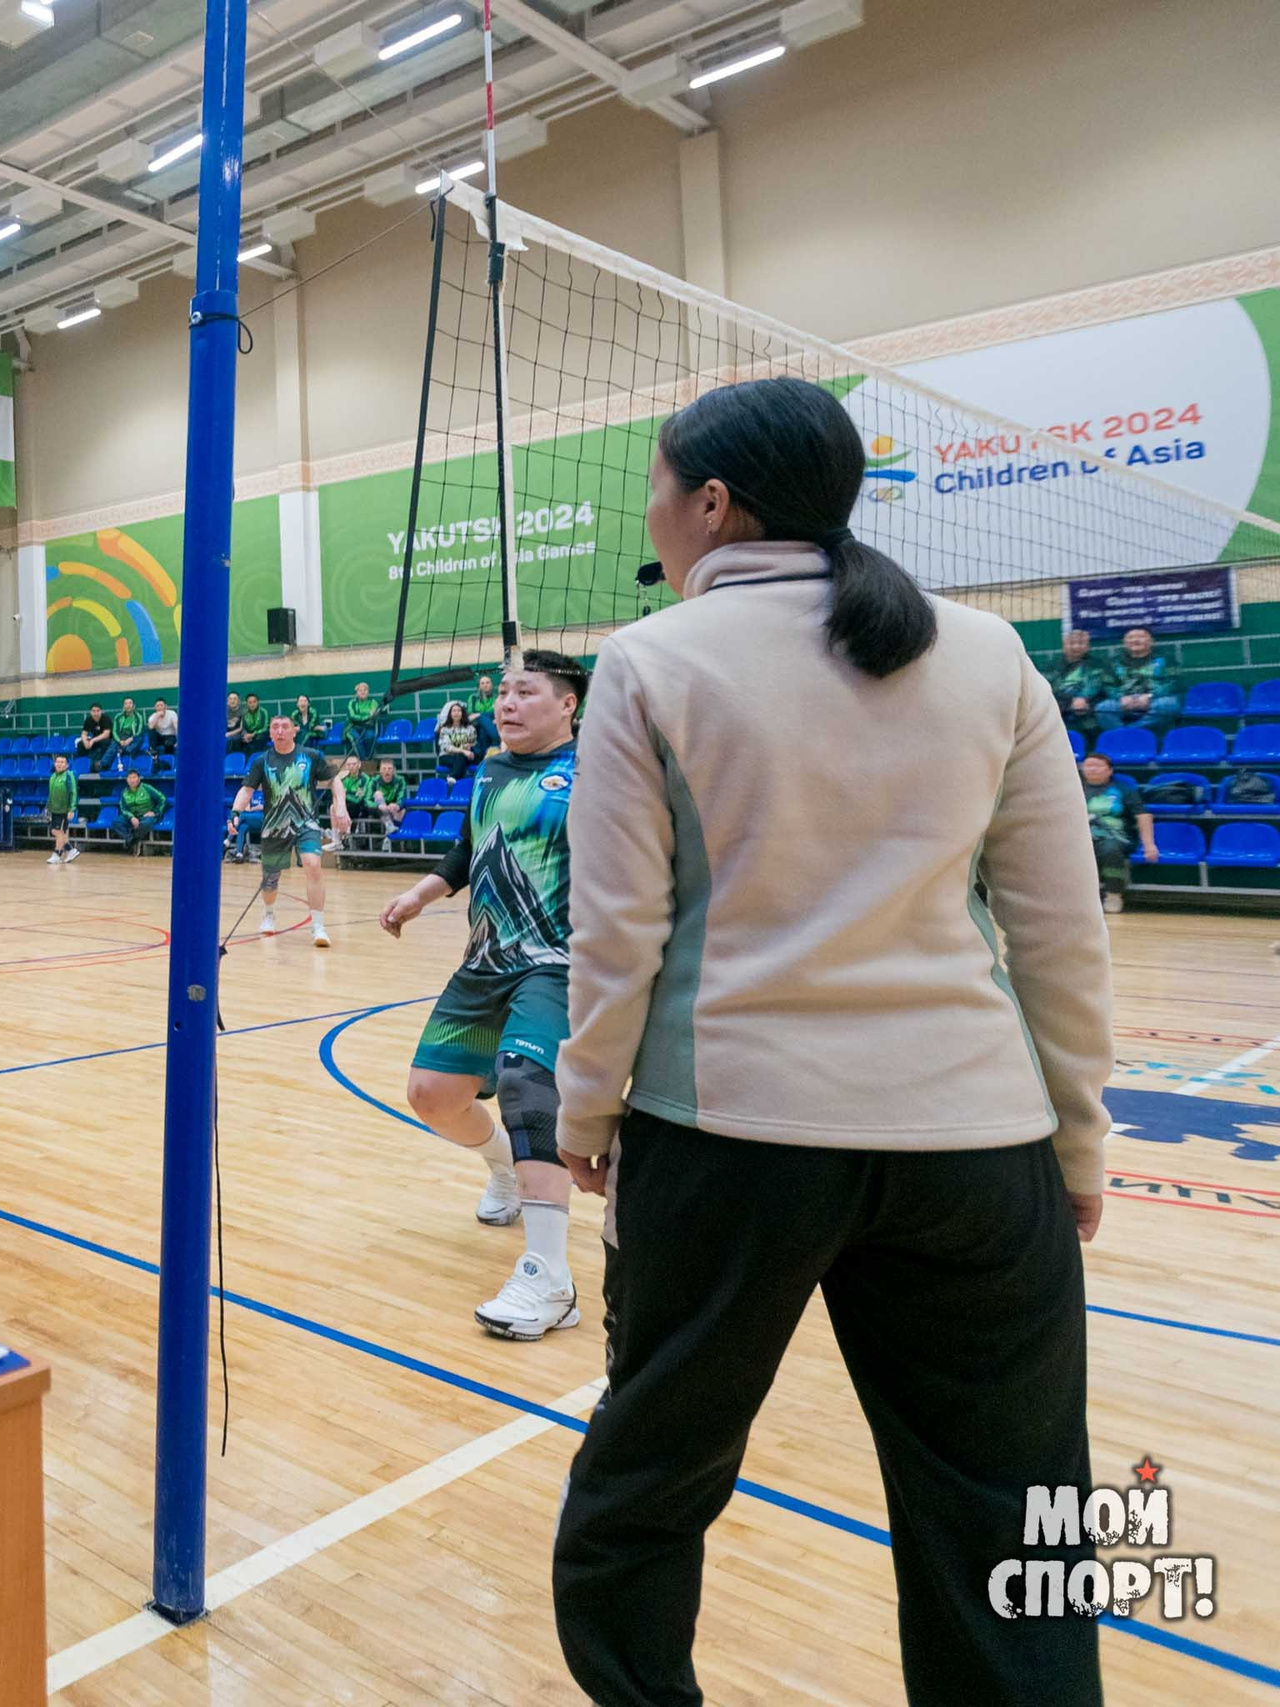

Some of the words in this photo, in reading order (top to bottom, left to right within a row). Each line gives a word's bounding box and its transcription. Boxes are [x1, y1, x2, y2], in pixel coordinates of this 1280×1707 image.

[934, 420, 1094, 465] YAKUSK
[1103, 402, 1204, 440] 2024
[934, 459, 1070, 495] Children
[1126, 437, 1207, 467] Asia
[517, 500, 595, 537] 2024
[416, 554, 477, 577] Children
[480, 551, 497, 568] of
[537, 541, 596, 561] Games
